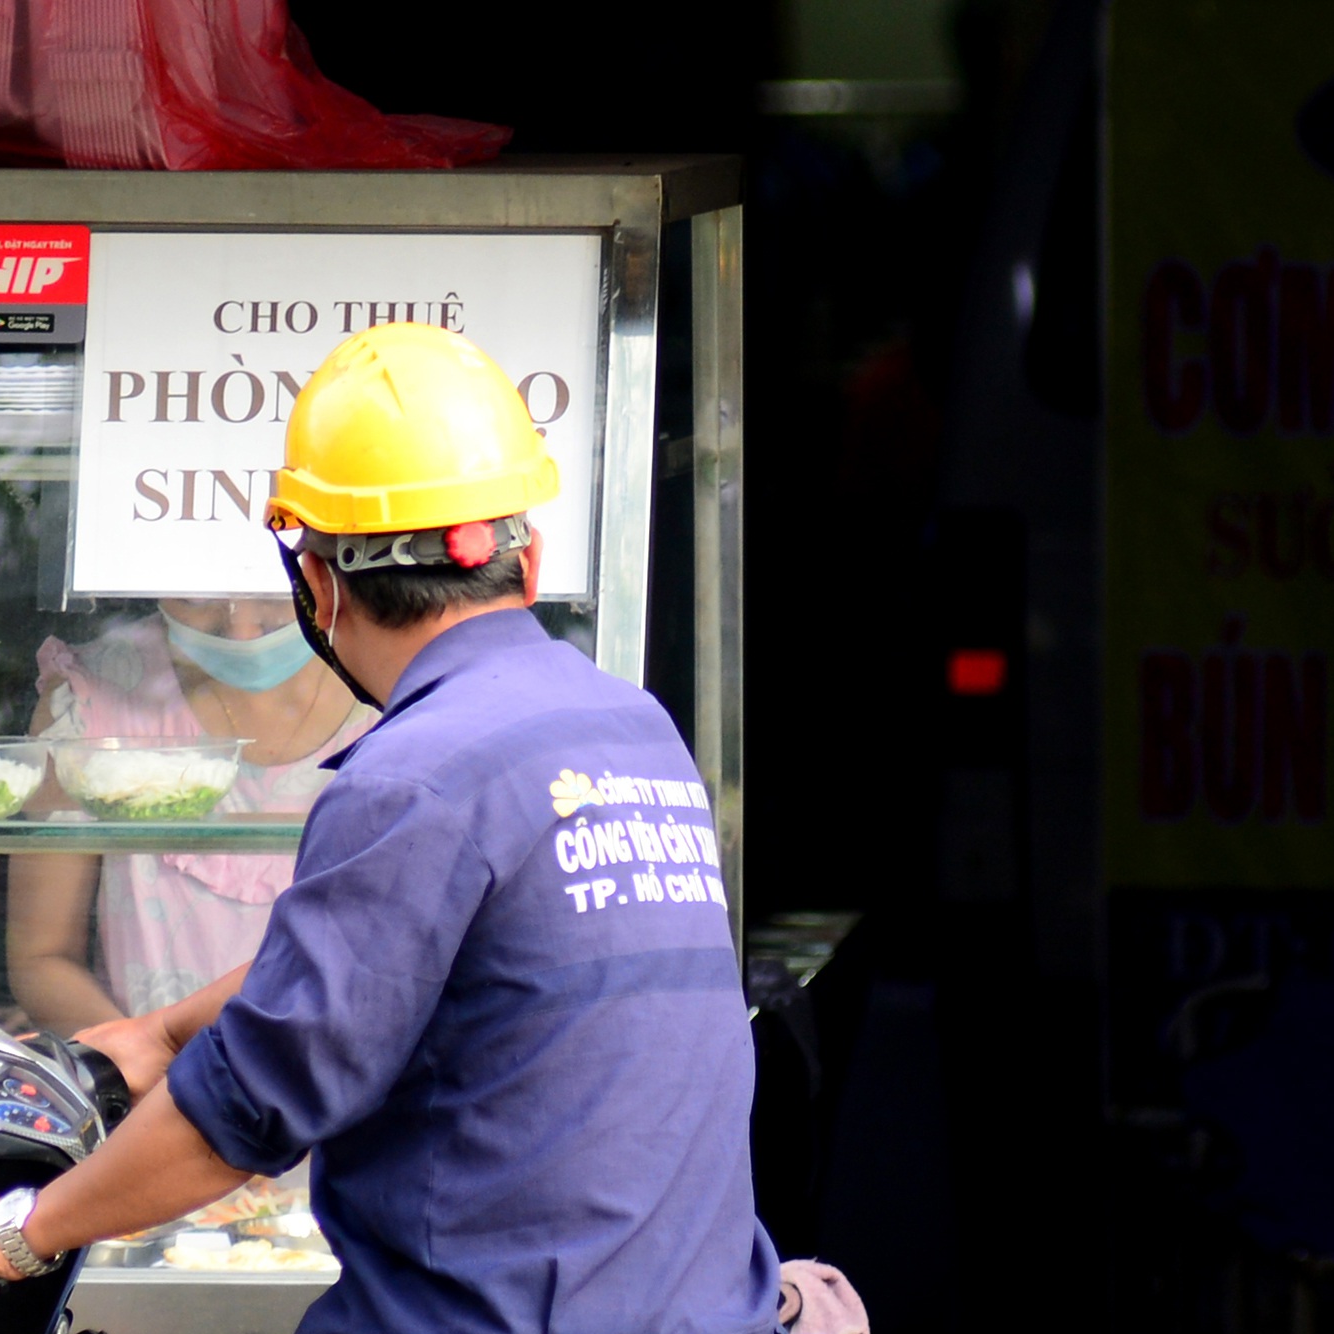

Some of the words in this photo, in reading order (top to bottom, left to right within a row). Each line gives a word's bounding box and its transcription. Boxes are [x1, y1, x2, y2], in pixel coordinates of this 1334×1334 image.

[213, 299, 318, 334] CHO
[334, 292, 465, 334] THUÊ
[102, 354, 313, 423] PHÒN
[1140, 611, 1326, 825] BÚN
[556, 817, 633, 873] CÔNG
[564, 878, 628, 913] TP.
[666, 868, 707, 902] CHÍ
